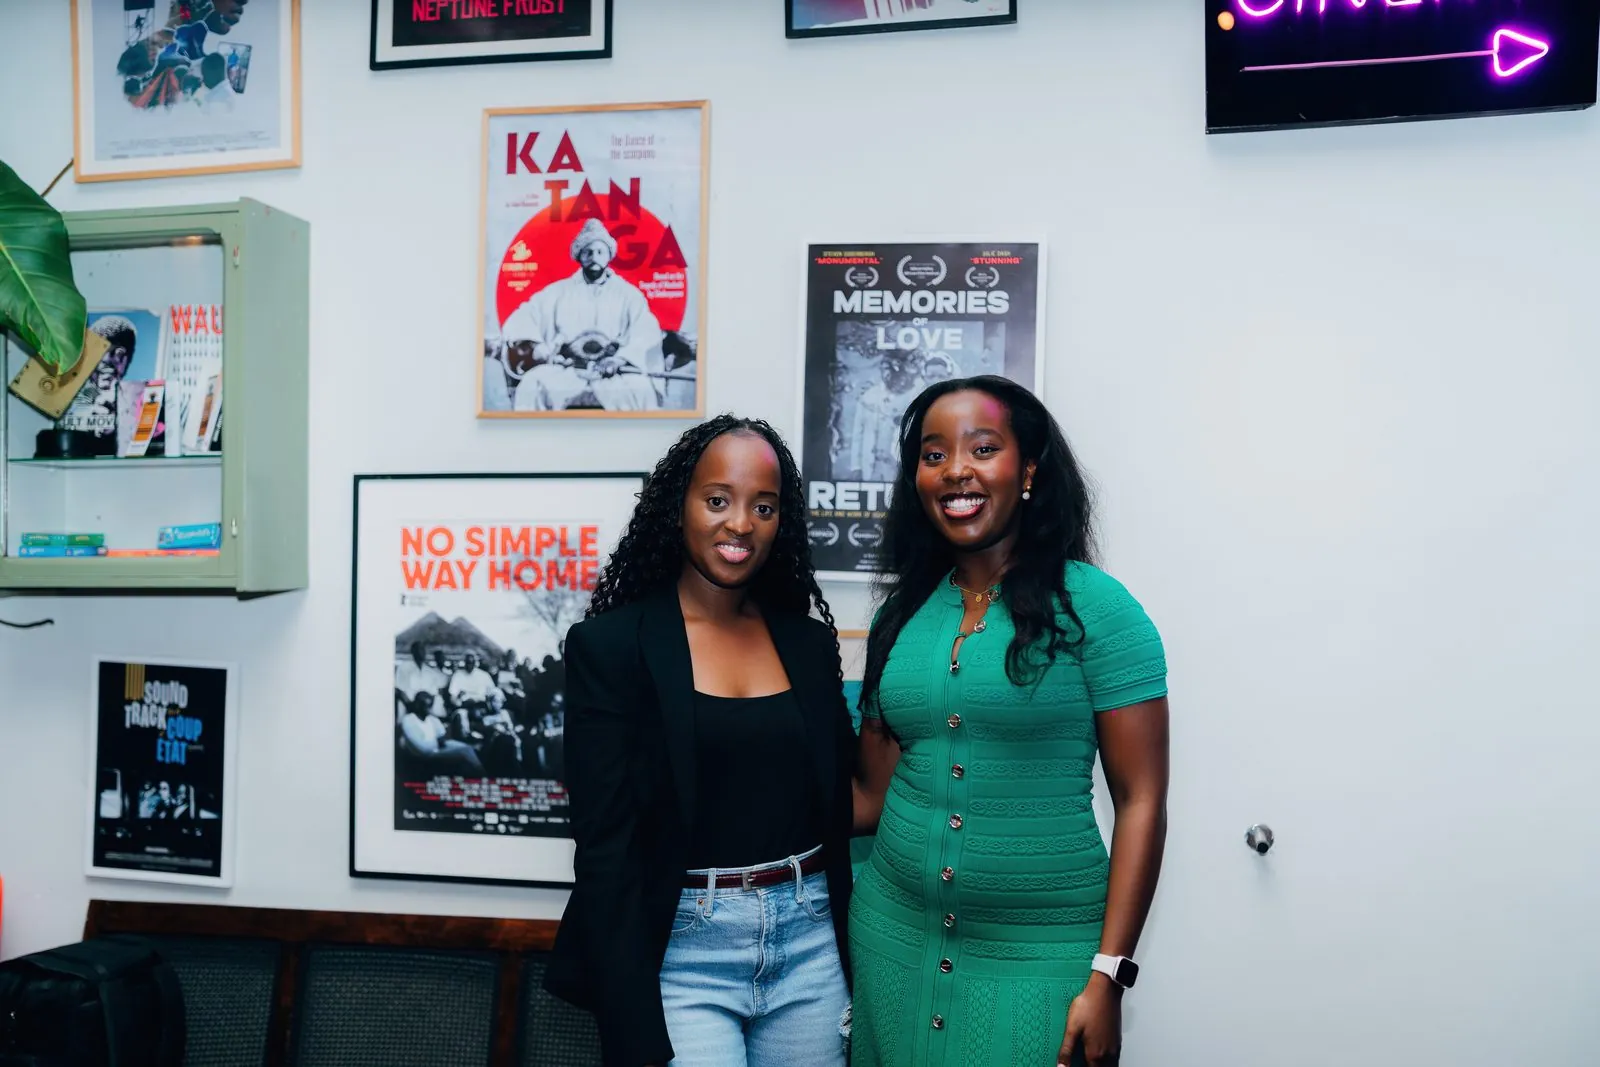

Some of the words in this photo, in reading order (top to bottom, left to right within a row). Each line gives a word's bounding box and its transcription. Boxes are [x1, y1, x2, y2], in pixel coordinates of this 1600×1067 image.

[412, 0, 499, 21] NEPTUNE
[507, 130, 584, 174] KA
[544, 177, 641, 222] TAN
[609, 223, 688, 270] GA
[833, 290, 1010, 314] MEMORIES
[912, 317, 928, 326] OF
[876, 327, 963, 350] LOVE
[401, 527, 454, 556] NO
[465, 526, 598, 557] SIMPLE
[401, 560, 476, 590] WAY
[488, 560, 599, 591] HOME
[144, 680, 188, 708] SOUND
[124, 701, 167, 730] TRACK
[167, 715, 202, 741] COUP
[156, 738, 188, 765] ETAT
